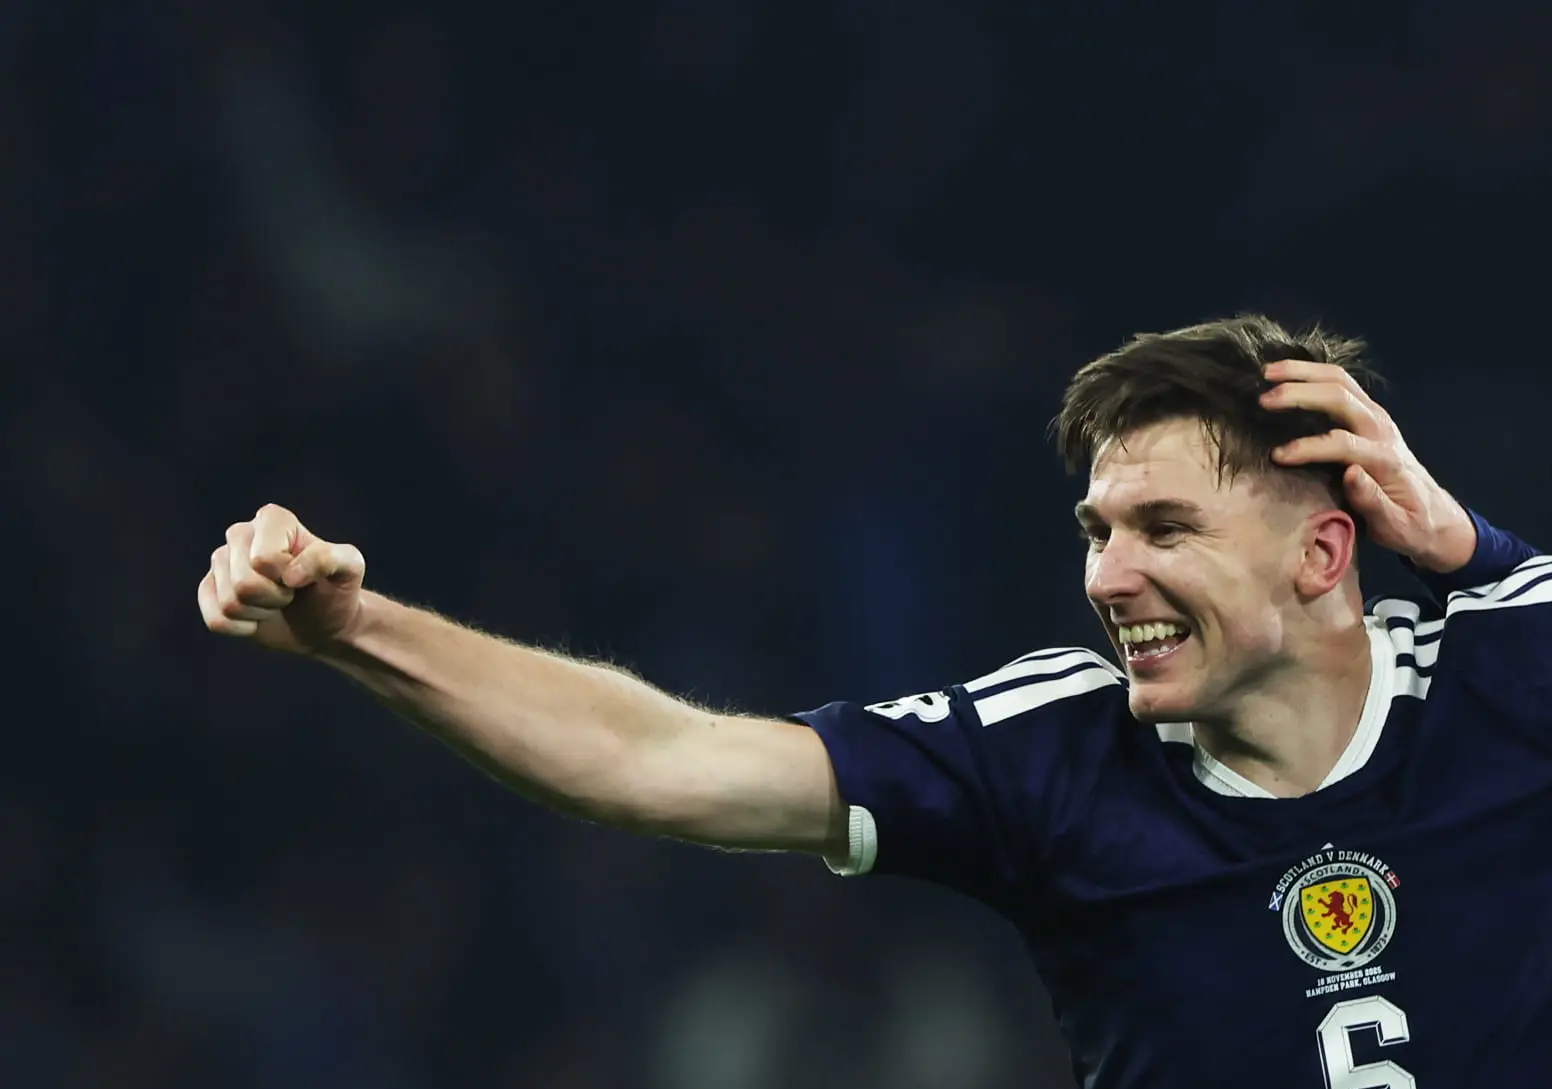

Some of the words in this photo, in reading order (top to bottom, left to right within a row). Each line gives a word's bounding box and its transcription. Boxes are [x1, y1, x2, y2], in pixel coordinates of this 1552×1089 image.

[1276, 854, 1324, 893] SCOTLAND
[1326, 852, 1334, 862] V
[1338, 850, 1389, 876] DENMARK
